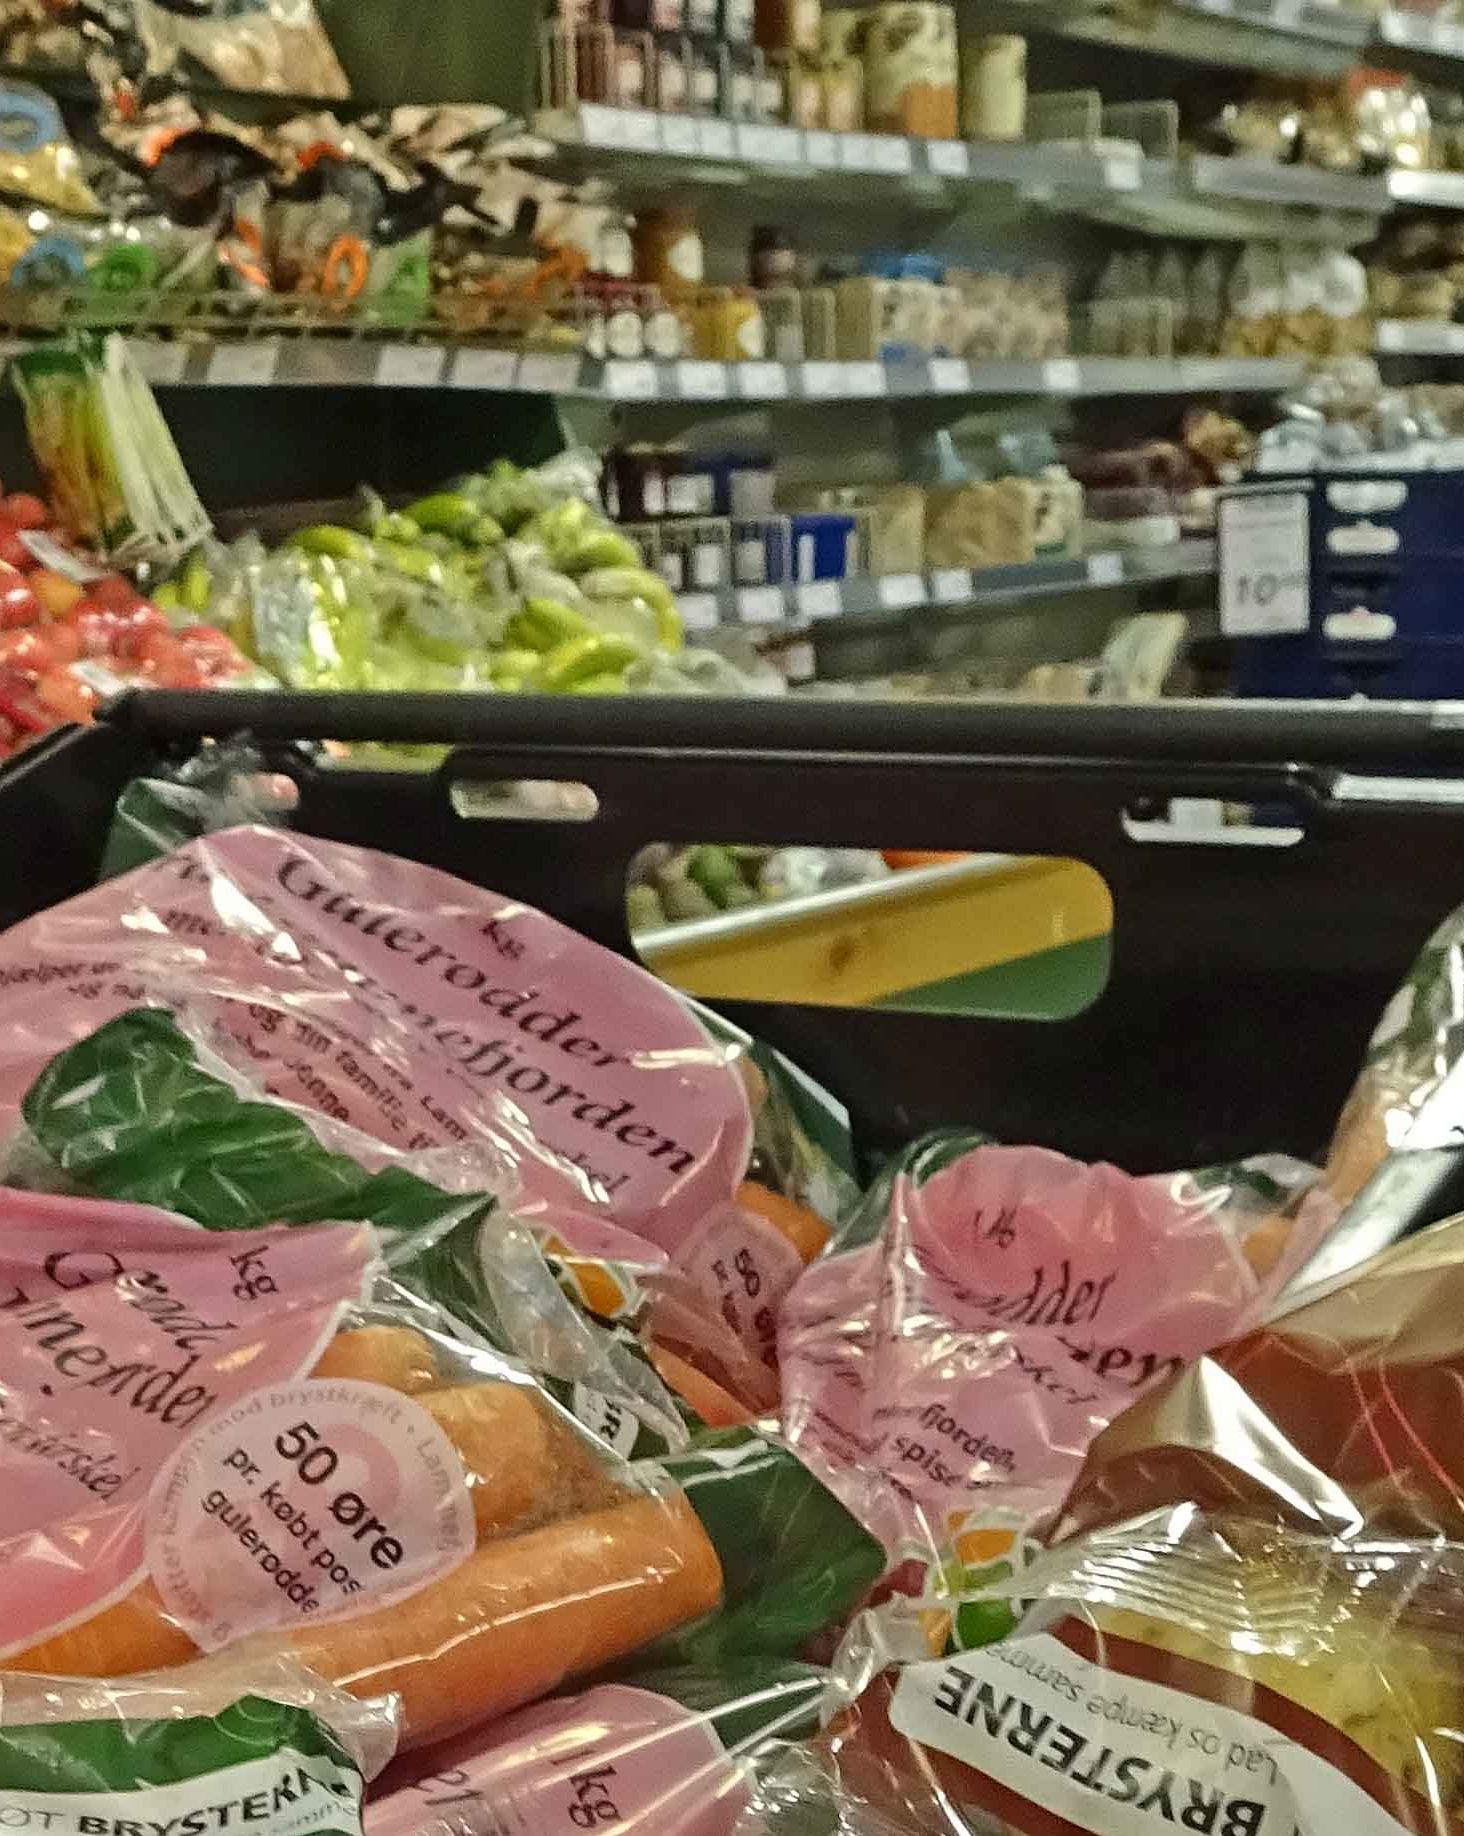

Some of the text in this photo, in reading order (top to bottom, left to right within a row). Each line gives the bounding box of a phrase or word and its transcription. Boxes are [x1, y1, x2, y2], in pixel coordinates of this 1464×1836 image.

[222, 1447, 262, 1486] pr.
[260, 1480, 321, 1551] købt
[275, 1421, 404, 1570] 50 øre
[1189, 1728, 1222, 1756] os
[1224, 1740, 1279, 1786] Lad
